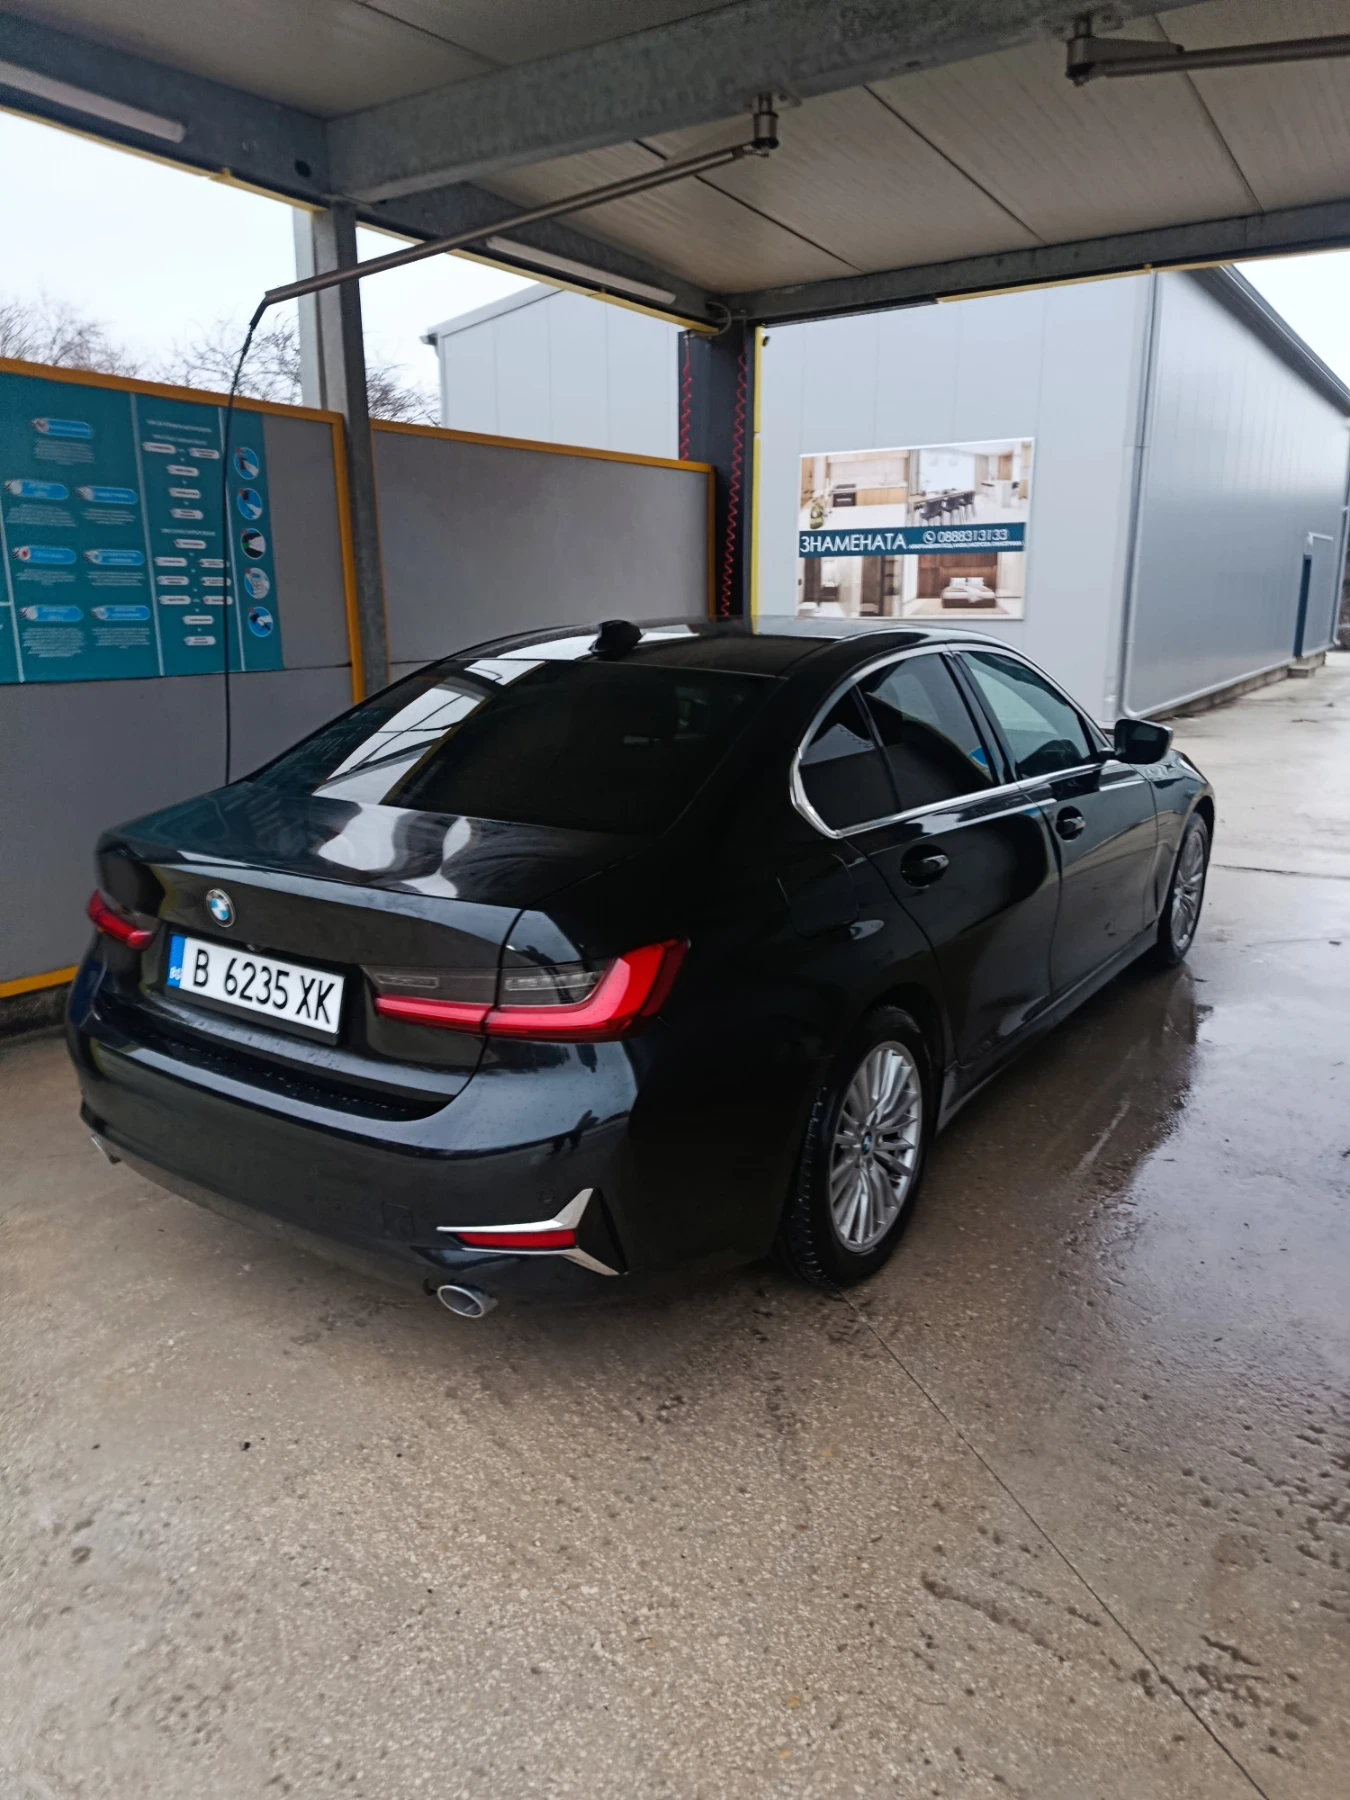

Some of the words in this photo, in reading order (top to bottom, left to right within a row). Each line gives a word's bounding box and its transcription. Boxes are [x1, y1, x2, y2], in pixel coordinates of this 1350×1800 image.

[799, 533, 907, 553] ЗНАМЕНАТА
[937, 529, 1008, 543] 0888313133
[193, 949, 209, 987] B
[225, 958, 289, 1009] 6235
[296, 975, 335, 1024] XK
